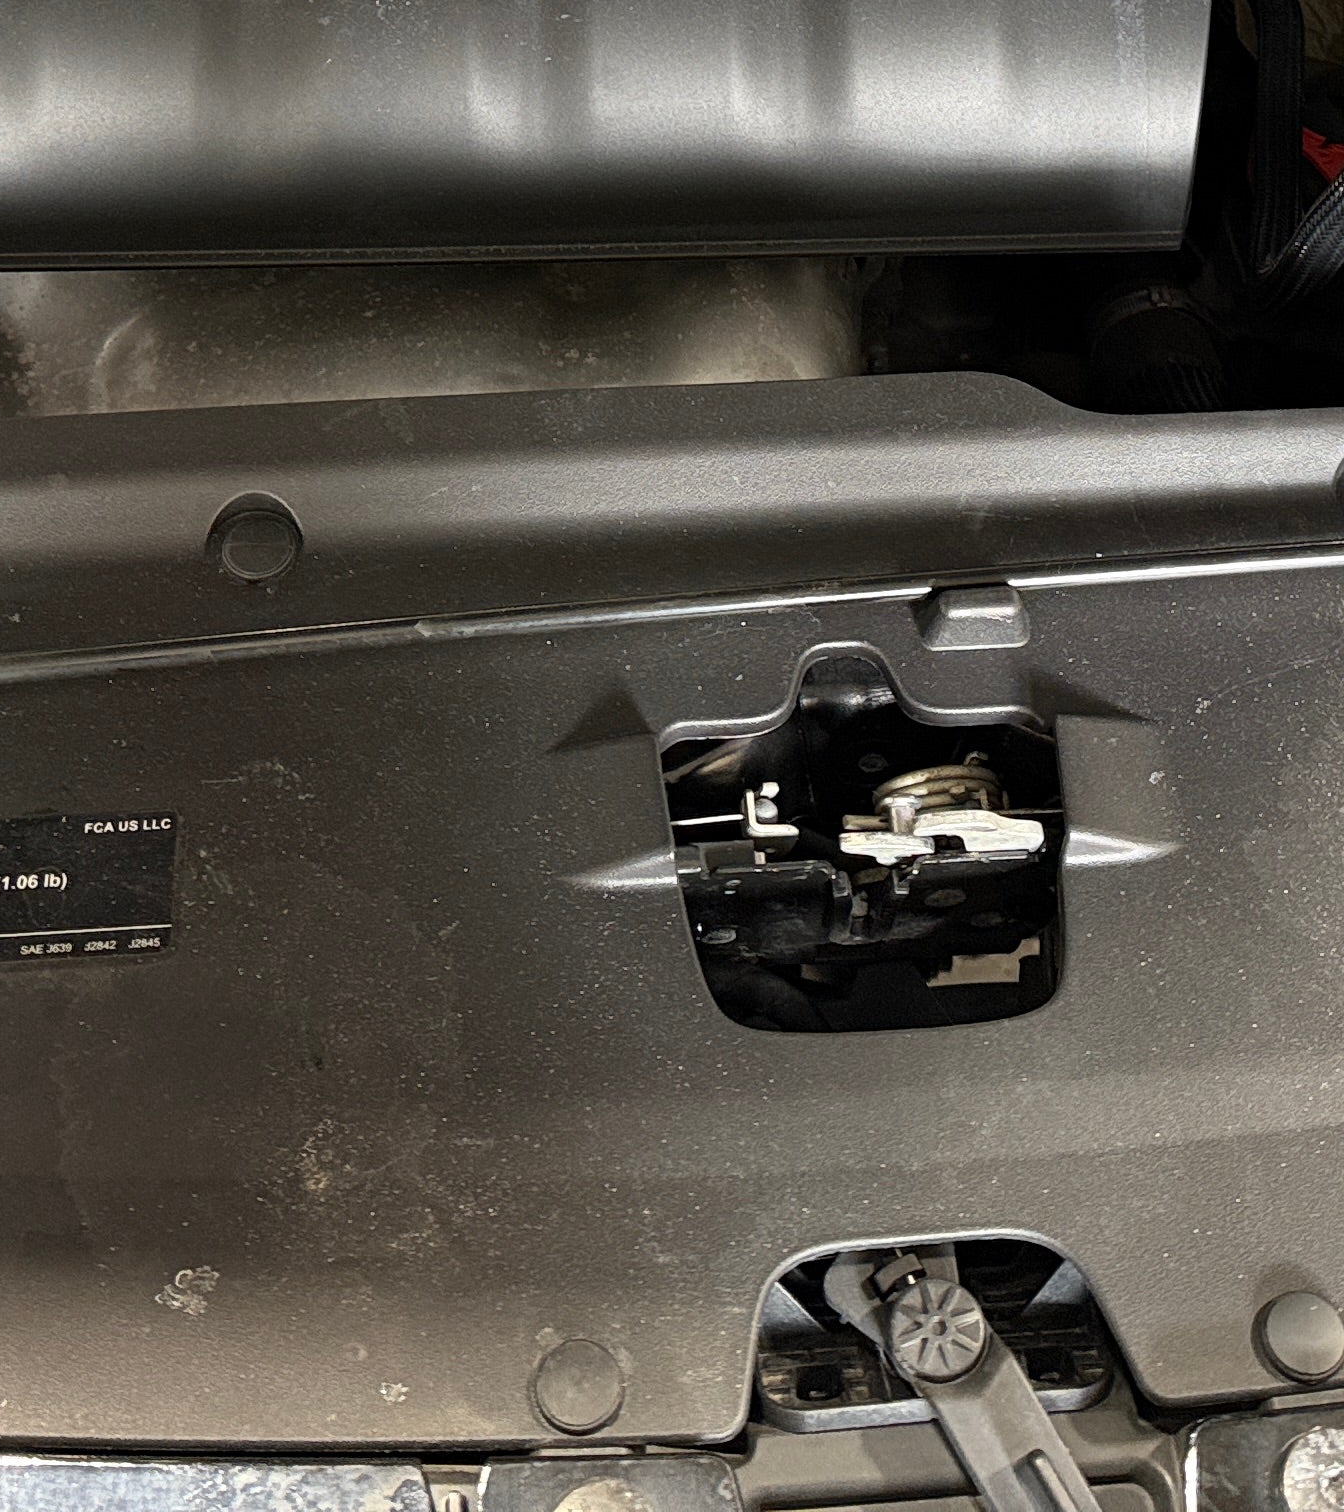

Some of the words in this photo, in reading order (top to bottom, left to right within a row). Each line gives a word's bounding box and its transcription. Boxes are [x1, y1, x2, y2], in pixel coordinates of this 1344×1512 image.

[84, 821, 114, 833] FCA
[118, 820, 139, 832] US
[142, 818, 172, 830] LLC
[43, 873, 68, 891] lb)
[19, 944, 44, 955] SAE
[46, 943, 72, 954] J639
[84, 940, 117, 952] J2842
[128, 937, 160, 949] J2845
